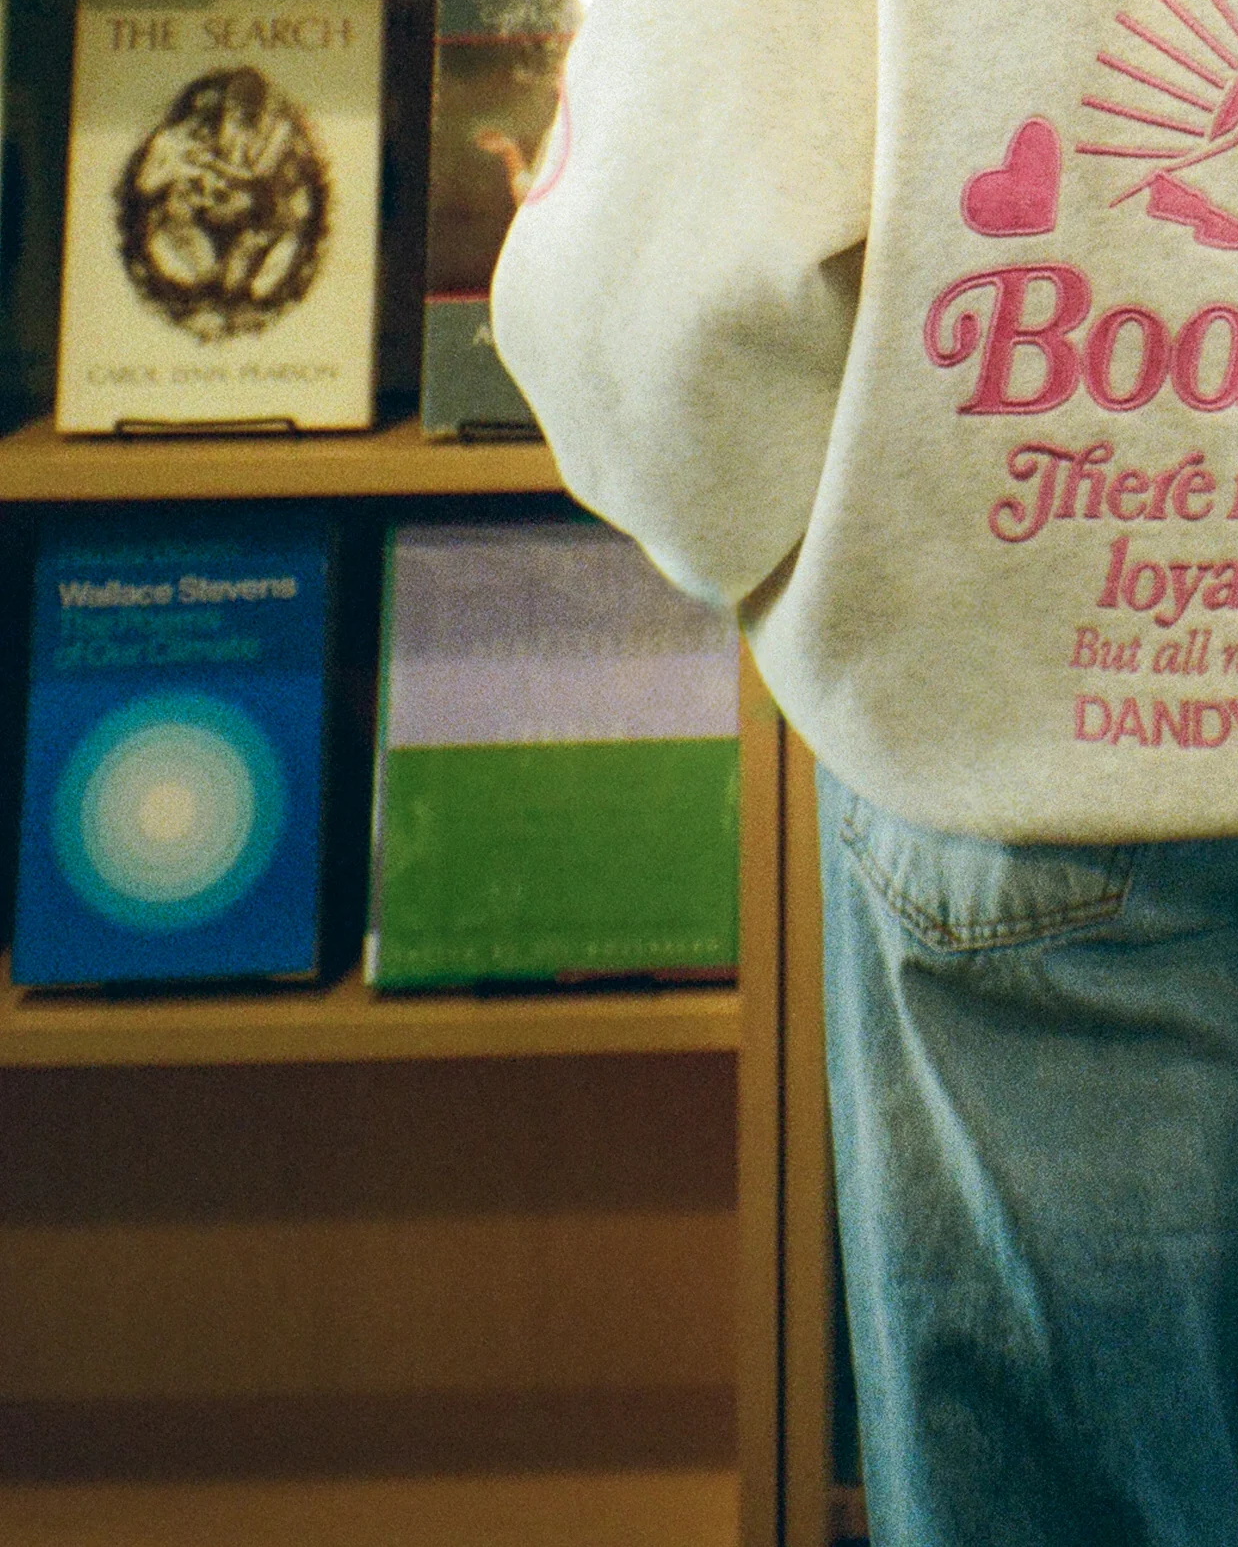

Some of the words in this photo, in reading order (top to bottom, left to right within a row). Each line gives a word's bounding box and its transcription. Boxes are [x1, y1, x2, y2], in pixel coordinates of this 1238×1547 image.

[108, 17, 177, 52] THE
[203, 15, 358, 50] SEARCH
[987, 439, 1217, 543] There
[57, 578, 174, 610] Wallace
[178, 571, 298, 604] Stevens
[1069, 624, 1142, 674] But
[1151, 626, 1213, 675] all
